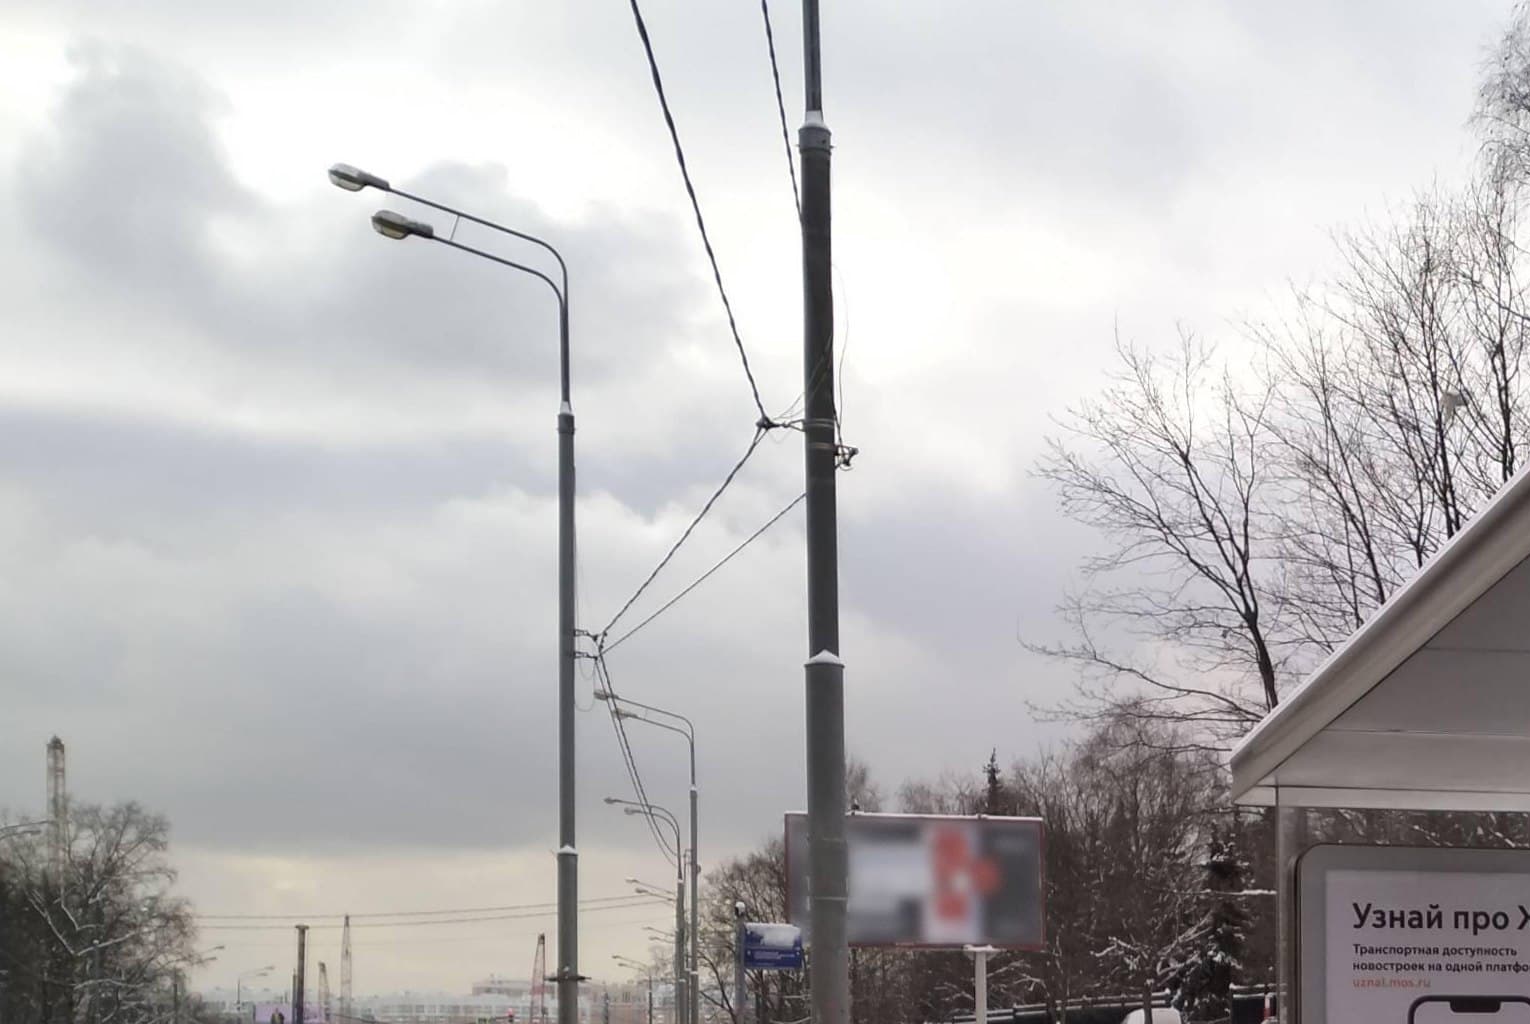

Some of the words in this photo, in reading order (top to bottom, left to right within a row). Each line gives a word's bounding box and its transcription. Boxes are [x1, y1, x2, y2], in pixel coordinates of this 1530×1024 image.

[1352, 902, 1444, 929] Узнай
[1453, 910, 1510, 936] про
[1353, 943, 1440, 957] Транспортная
[1442, 945, 1518, 958] доступность
[1352, 961, 1425, 974] новостроек
[1428, 963, 1443, 972] на
[1445, 961, 1483, 973] одной
